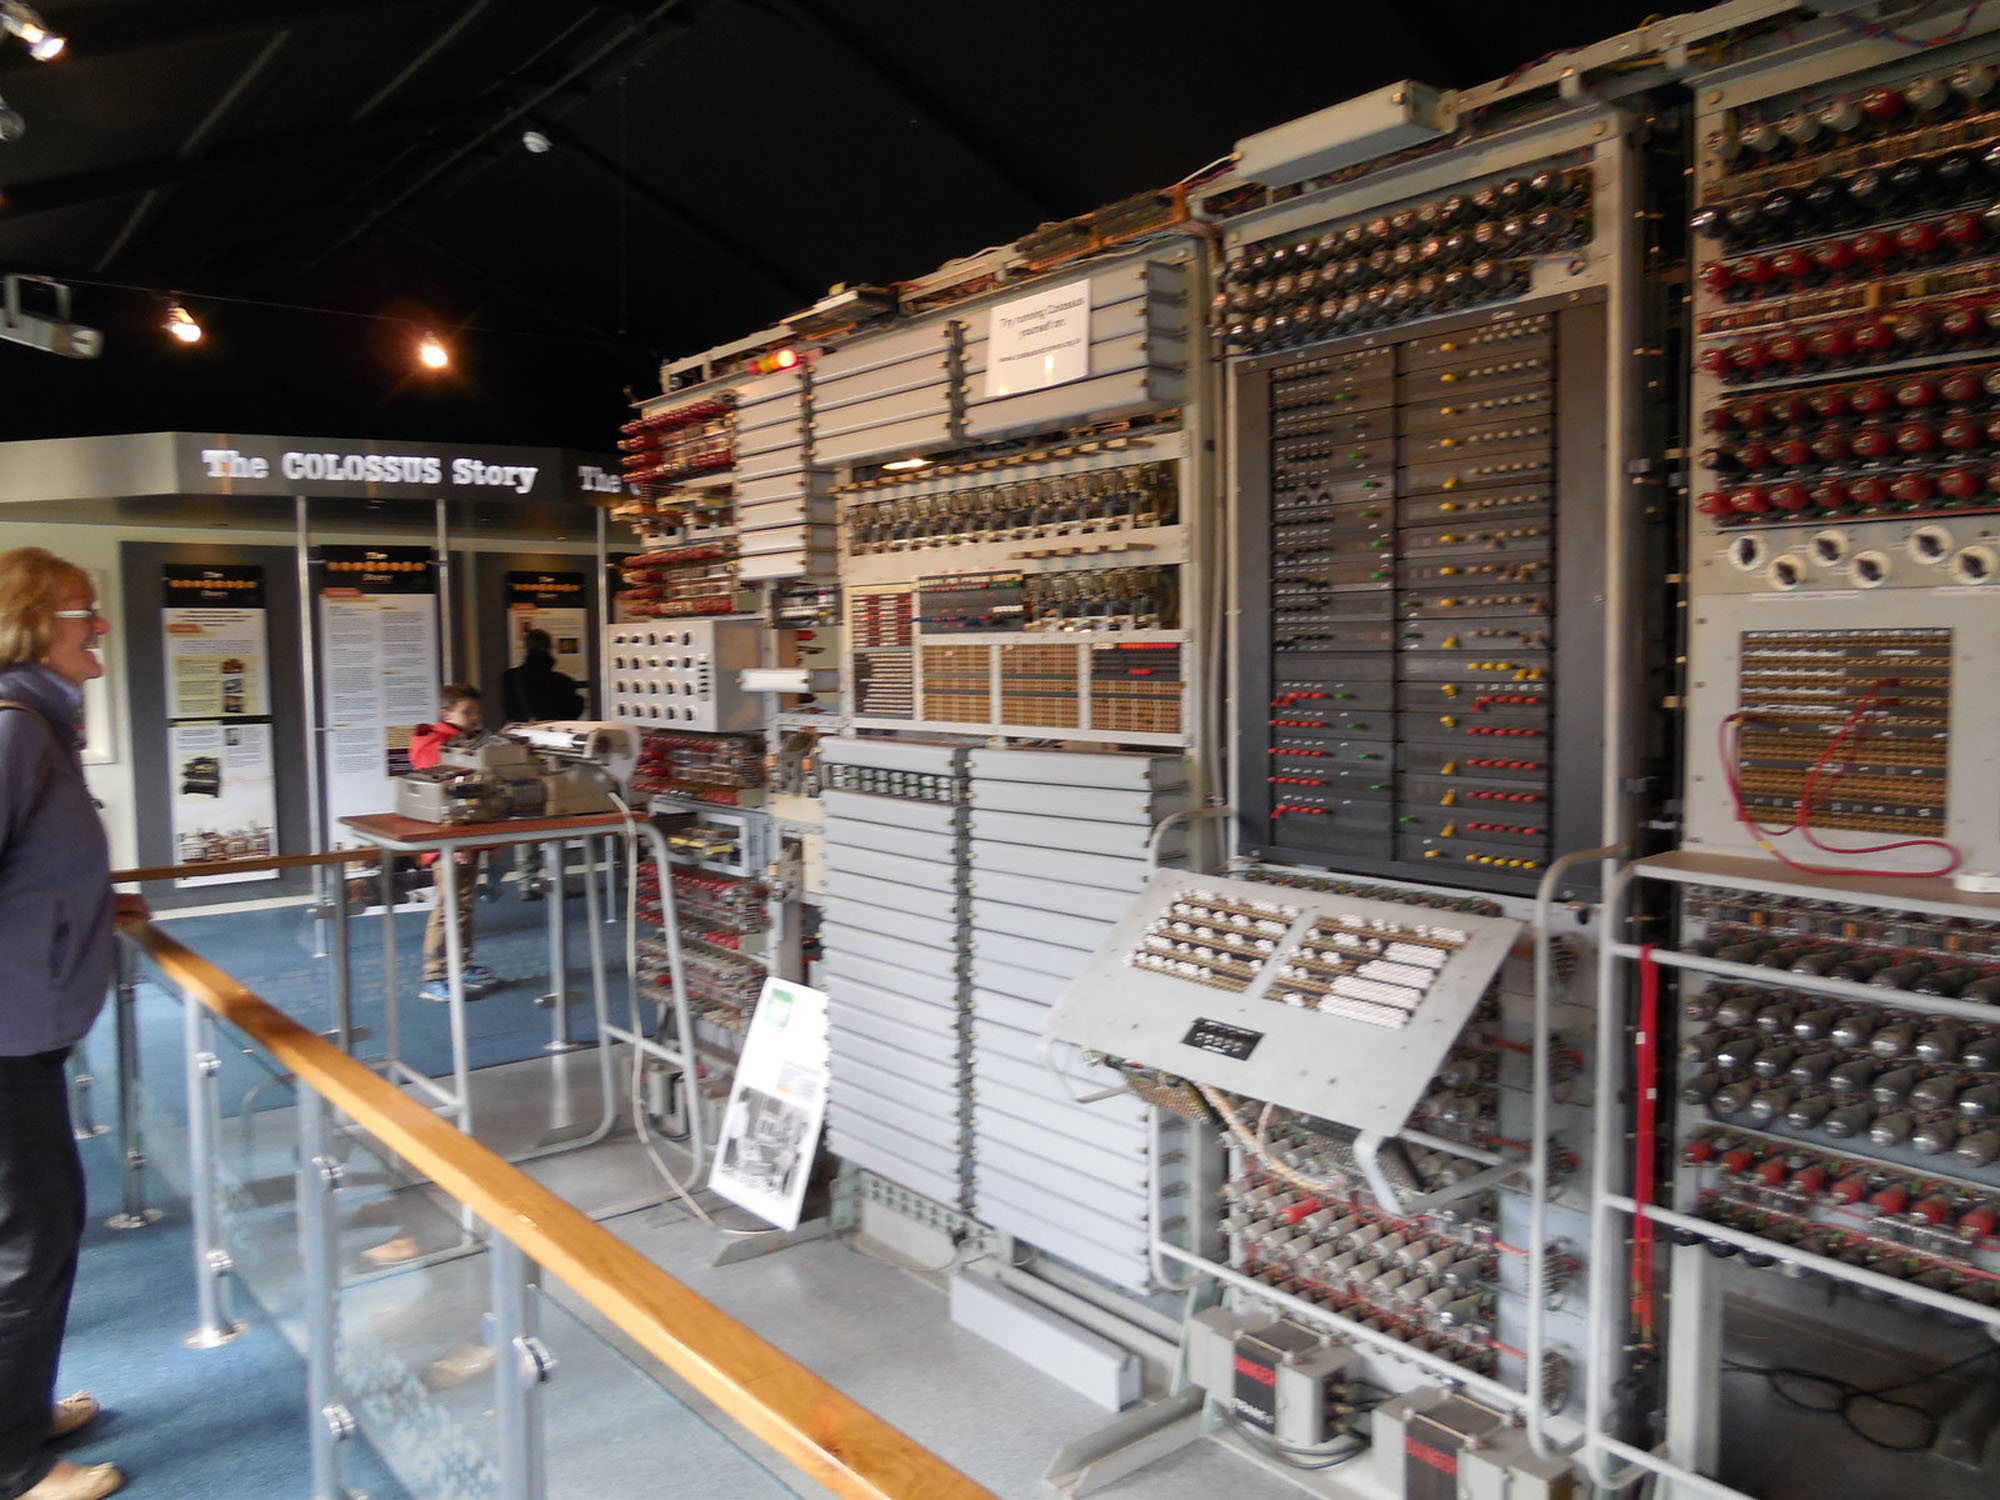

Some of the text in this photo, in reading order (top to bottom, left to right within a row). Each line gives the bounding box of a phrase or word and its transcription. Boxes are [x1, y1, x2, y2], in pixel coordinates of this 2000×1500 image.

[201, 449, 539, 494] The COLOSSUS Story
[577, 465, 622, 493] The
